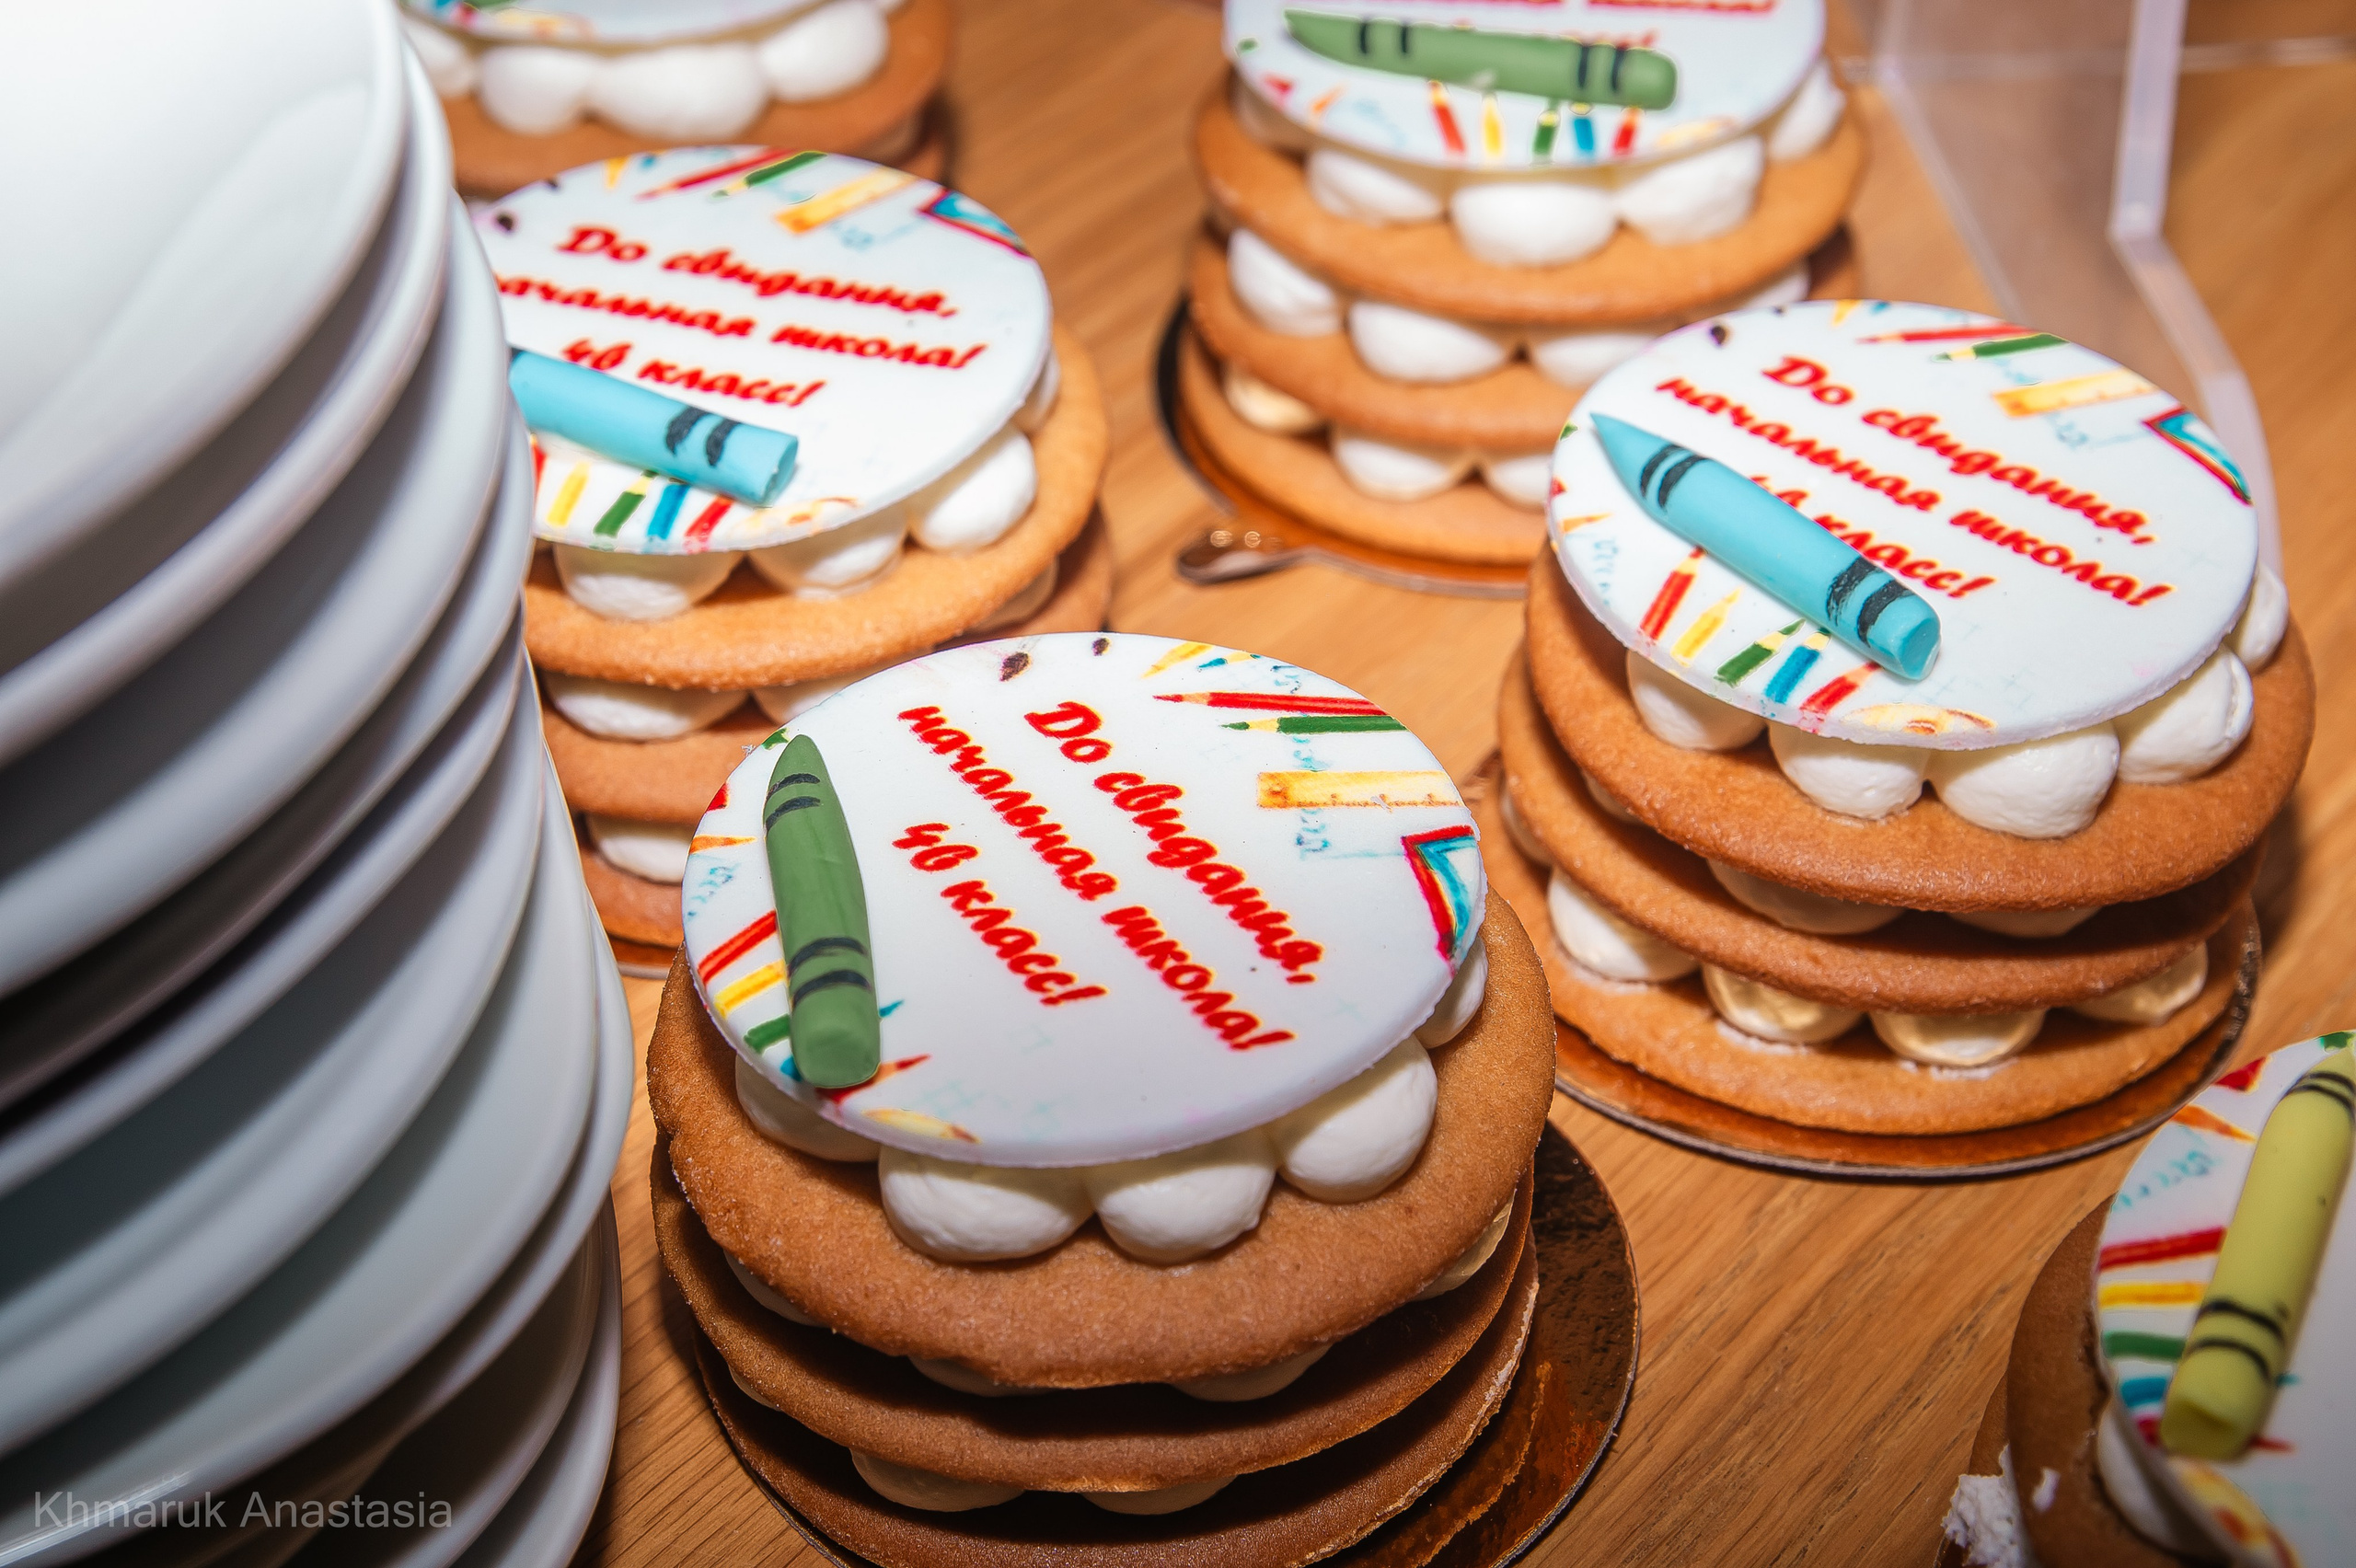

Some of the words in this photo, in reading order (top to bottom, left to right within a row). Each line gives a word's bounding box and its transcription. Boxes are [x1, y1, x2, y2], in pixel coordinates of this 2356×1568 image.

[557, 226, 650, 262] До
[660, 249, 959, 318] свидания,
[769, 325, 990, 372] школа!
[636, 359, 827, 408] класс!
[1761, 355, 1854, 407] До
[1861, 407, 2156, 547] свидания,
[1656, 376, 1941, 513] начальная
[1948, 509, 2177, 608] школа!
[891, 821, 979, 873] 4в
[940, 879, 1108, 1008] класс!
[896, 704, 1120, 904] начальная
[1100, 904, 1297, 1054] школа!
[1022, 699, 1114, 765] До
[1092, 771, 1325, 986] свидания,
